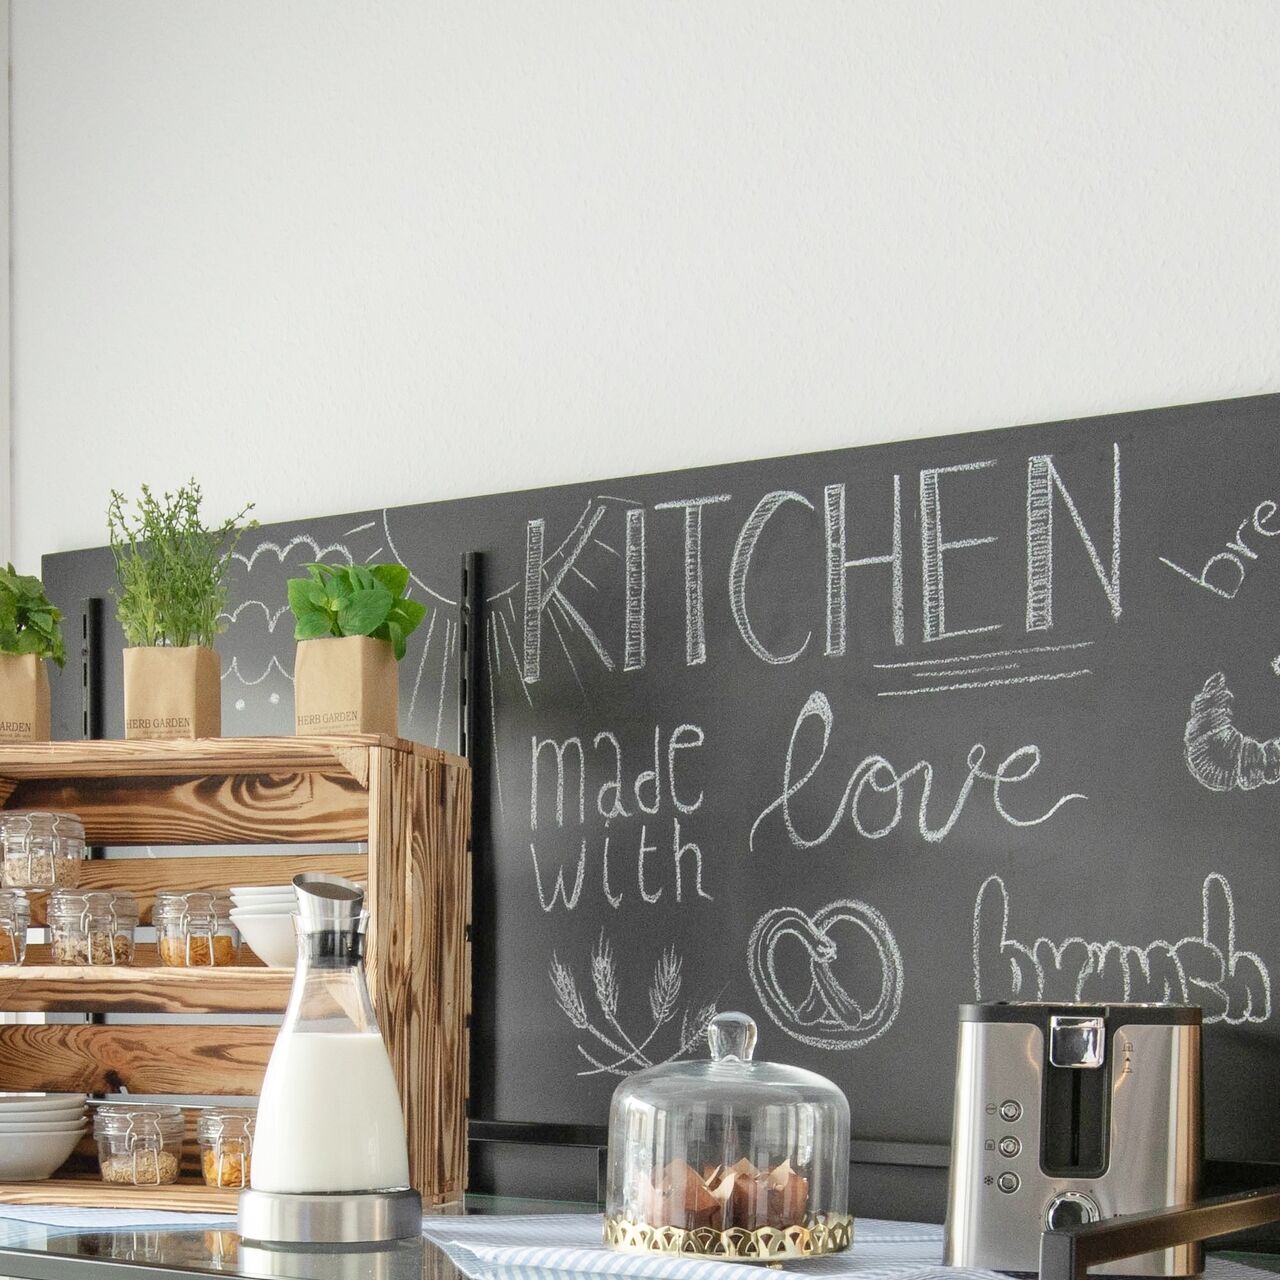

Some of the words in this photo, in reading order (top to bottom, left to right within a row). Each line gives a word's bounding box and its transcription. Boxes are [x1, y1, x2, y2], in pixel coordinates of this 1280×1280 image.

[523, 442, 1124, 685] KITCHEN
[153, 718, 190, 729] GARDEN
[297, 714, 320, 726] HERB
[323, 711, 358, 723] GARDEN
[530, 724, 705, 829] made
[749, 691, 1088, 849] love
[530, 816, 713, 911] with
